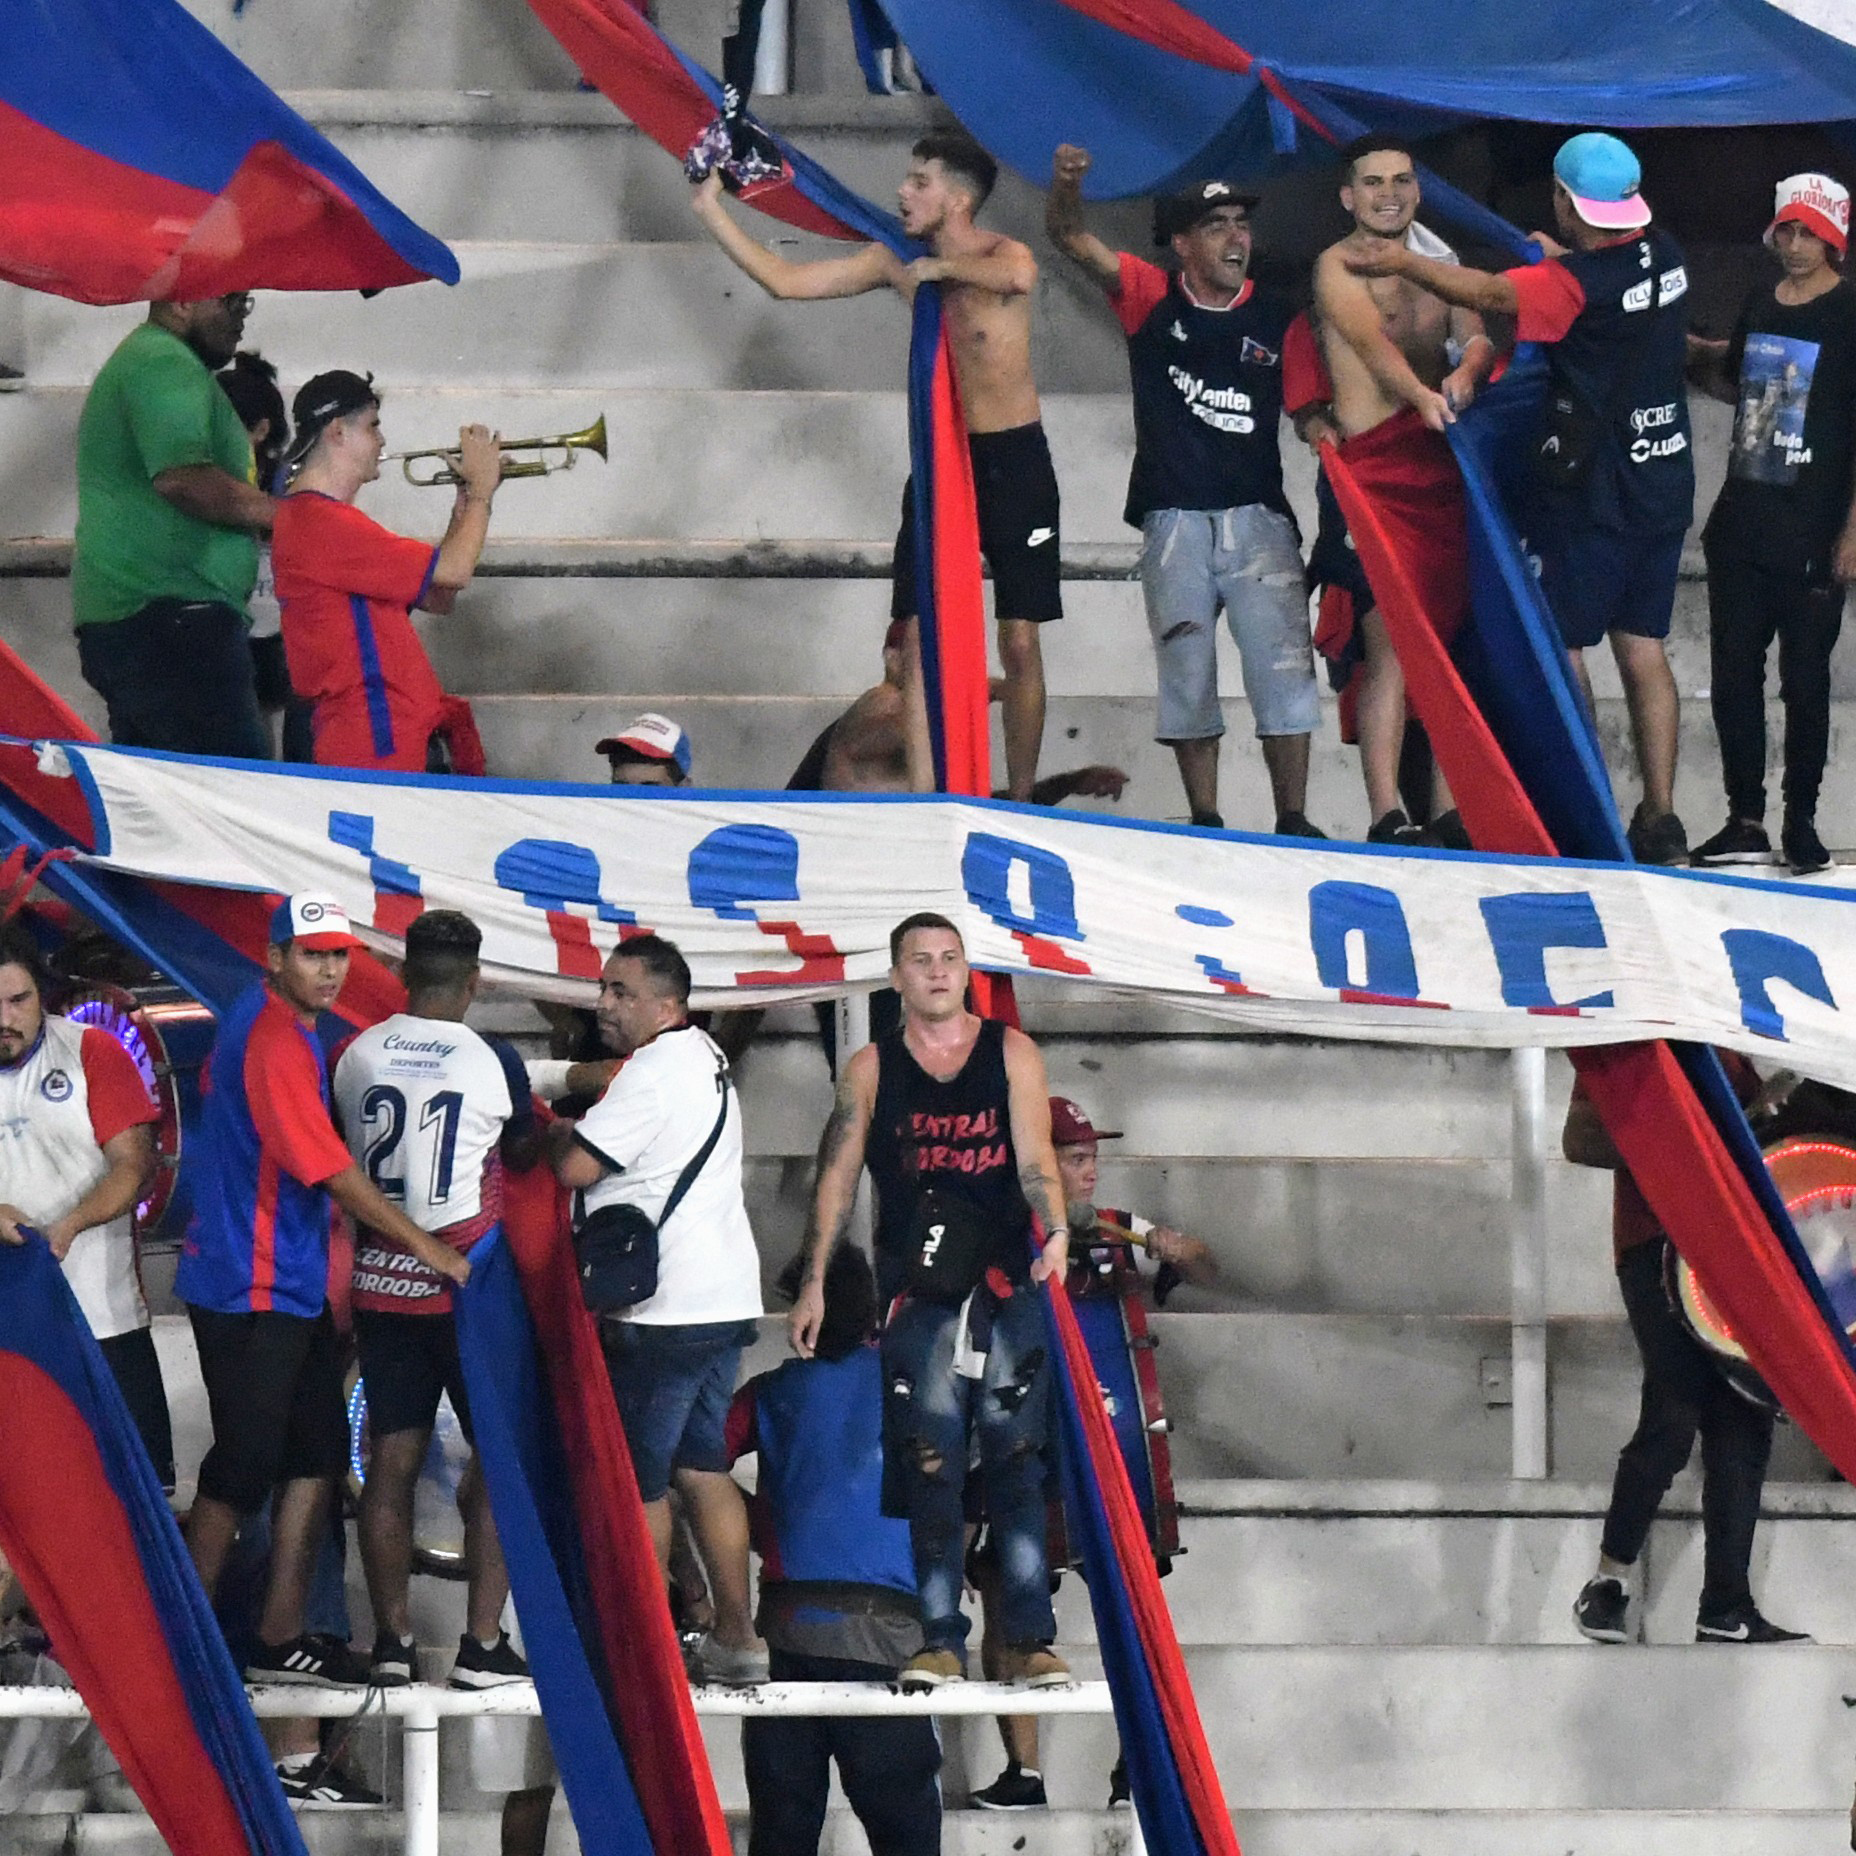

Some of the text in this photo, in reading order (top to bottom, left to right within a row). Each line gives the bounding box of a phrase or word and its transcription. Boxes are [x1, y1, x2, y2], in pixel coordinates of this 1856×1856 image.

[383, 1033, 457, 1058] Country
[359, 1084, 465, 1207] 21
[922, 1224, 945, 1267] FILA
